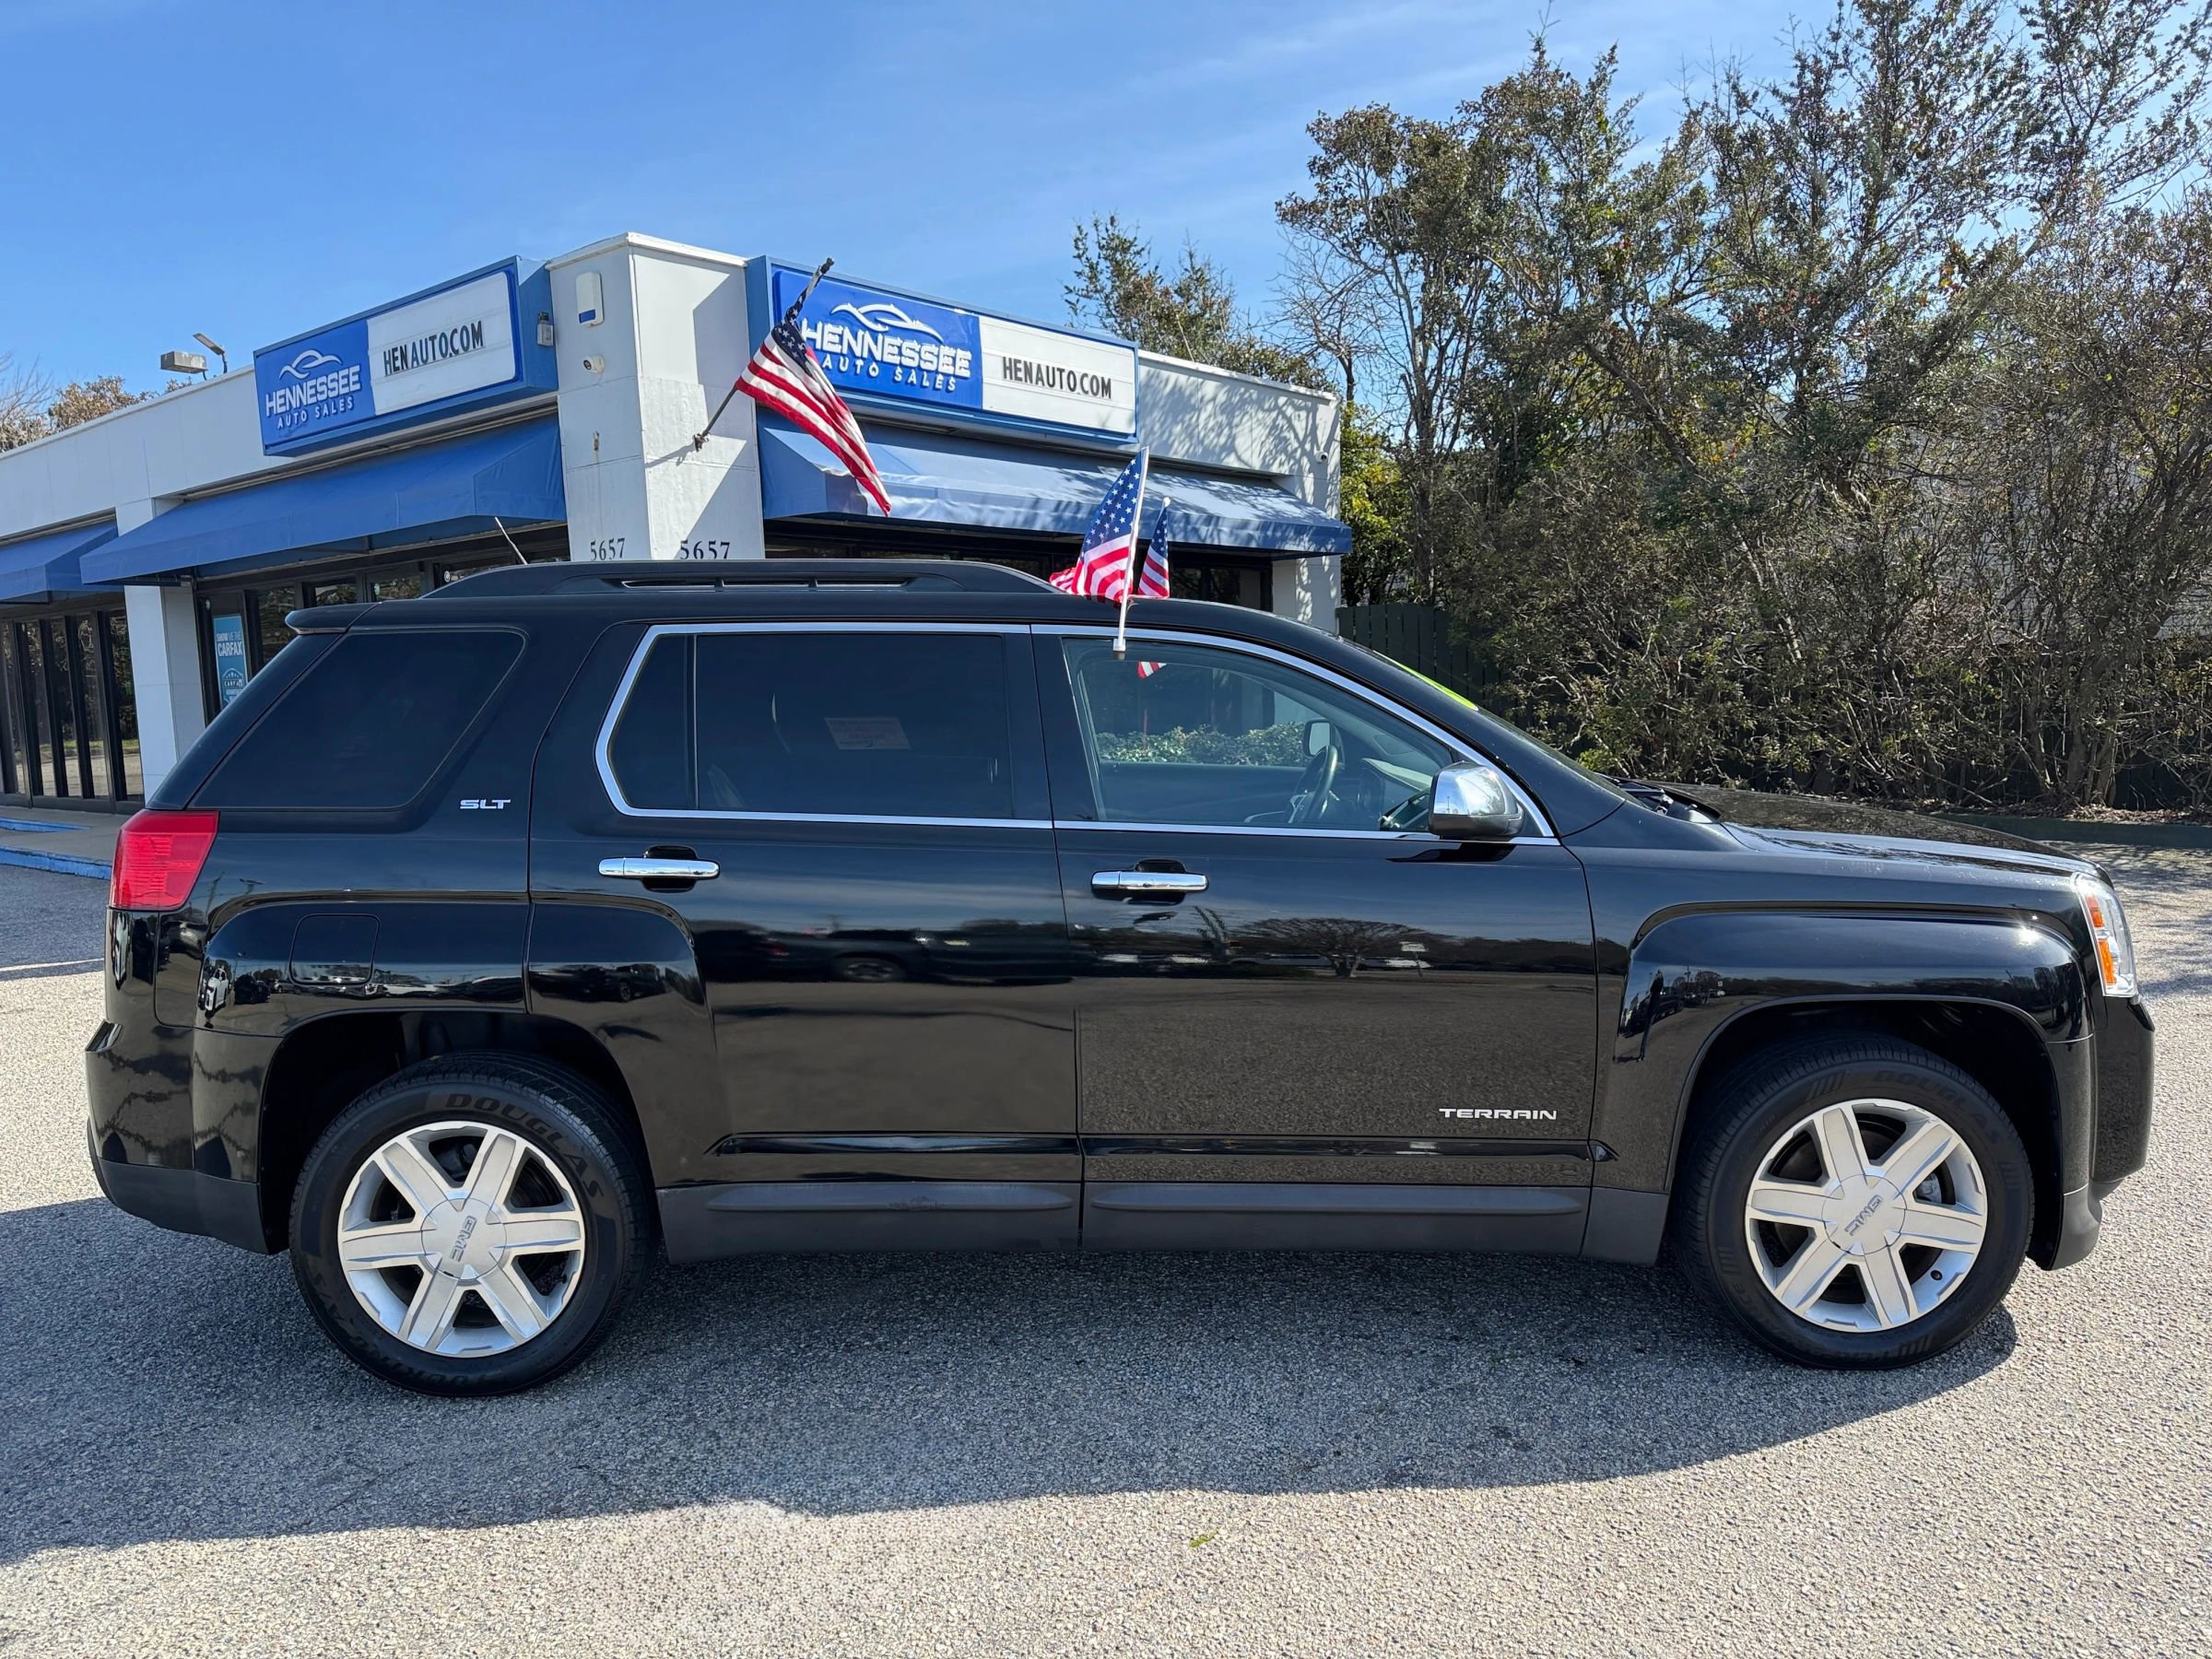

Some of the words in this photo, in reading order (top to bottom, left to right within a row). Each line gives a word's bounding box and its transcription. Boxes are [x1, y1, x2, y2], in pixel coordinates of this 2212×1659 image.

[382, 319, 484, 378] HENAUTO.COM
[801, 317, 972, 378] HENNESSEE
[821, 353, 880, 378] AUTO
[893, 367, 957, 392] SALES
[1002, 356, 1112, 399] HENAUTO.COM
[265, 365, 361, 417] HENNESSEE
[276, 410, 309, 429] AUTO
[314, 396, 355, 418] SALES
[590, 537, 626, 561] 5657
[679, 539, 731, 560] 5657
[218, 641, 242, 656] CARFAX
[459, 798, 512, 810] SLT
[1438, 1108, 1558, 1121] TERRAIN
[444, 1093, 606, 1200] DOUGLAS
